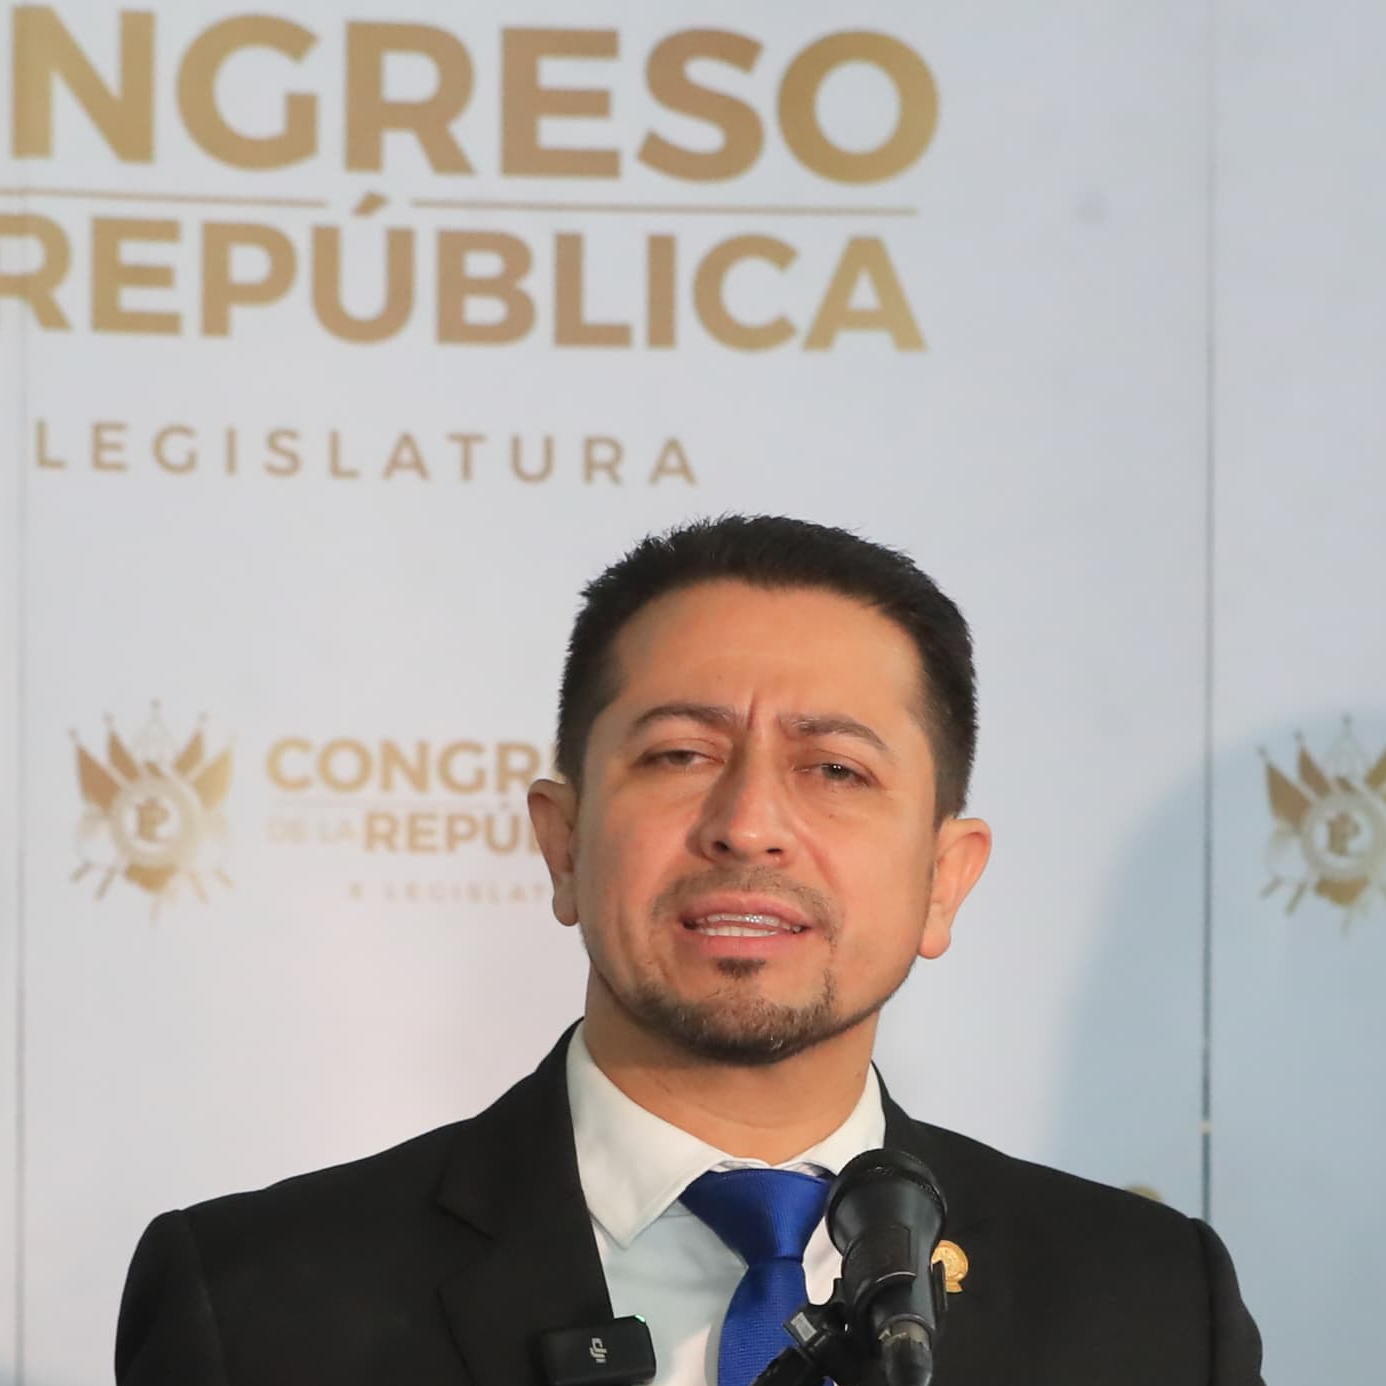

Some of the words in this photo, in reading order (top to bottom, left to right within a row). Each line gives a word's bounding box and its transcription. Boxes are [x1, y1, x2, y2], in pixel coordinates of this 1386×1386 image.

[34, 418, 698, 486] LEGISLATURA
[265, 737, 556, 797] CONGR
[363, 803, 544, 856] REPÚ
